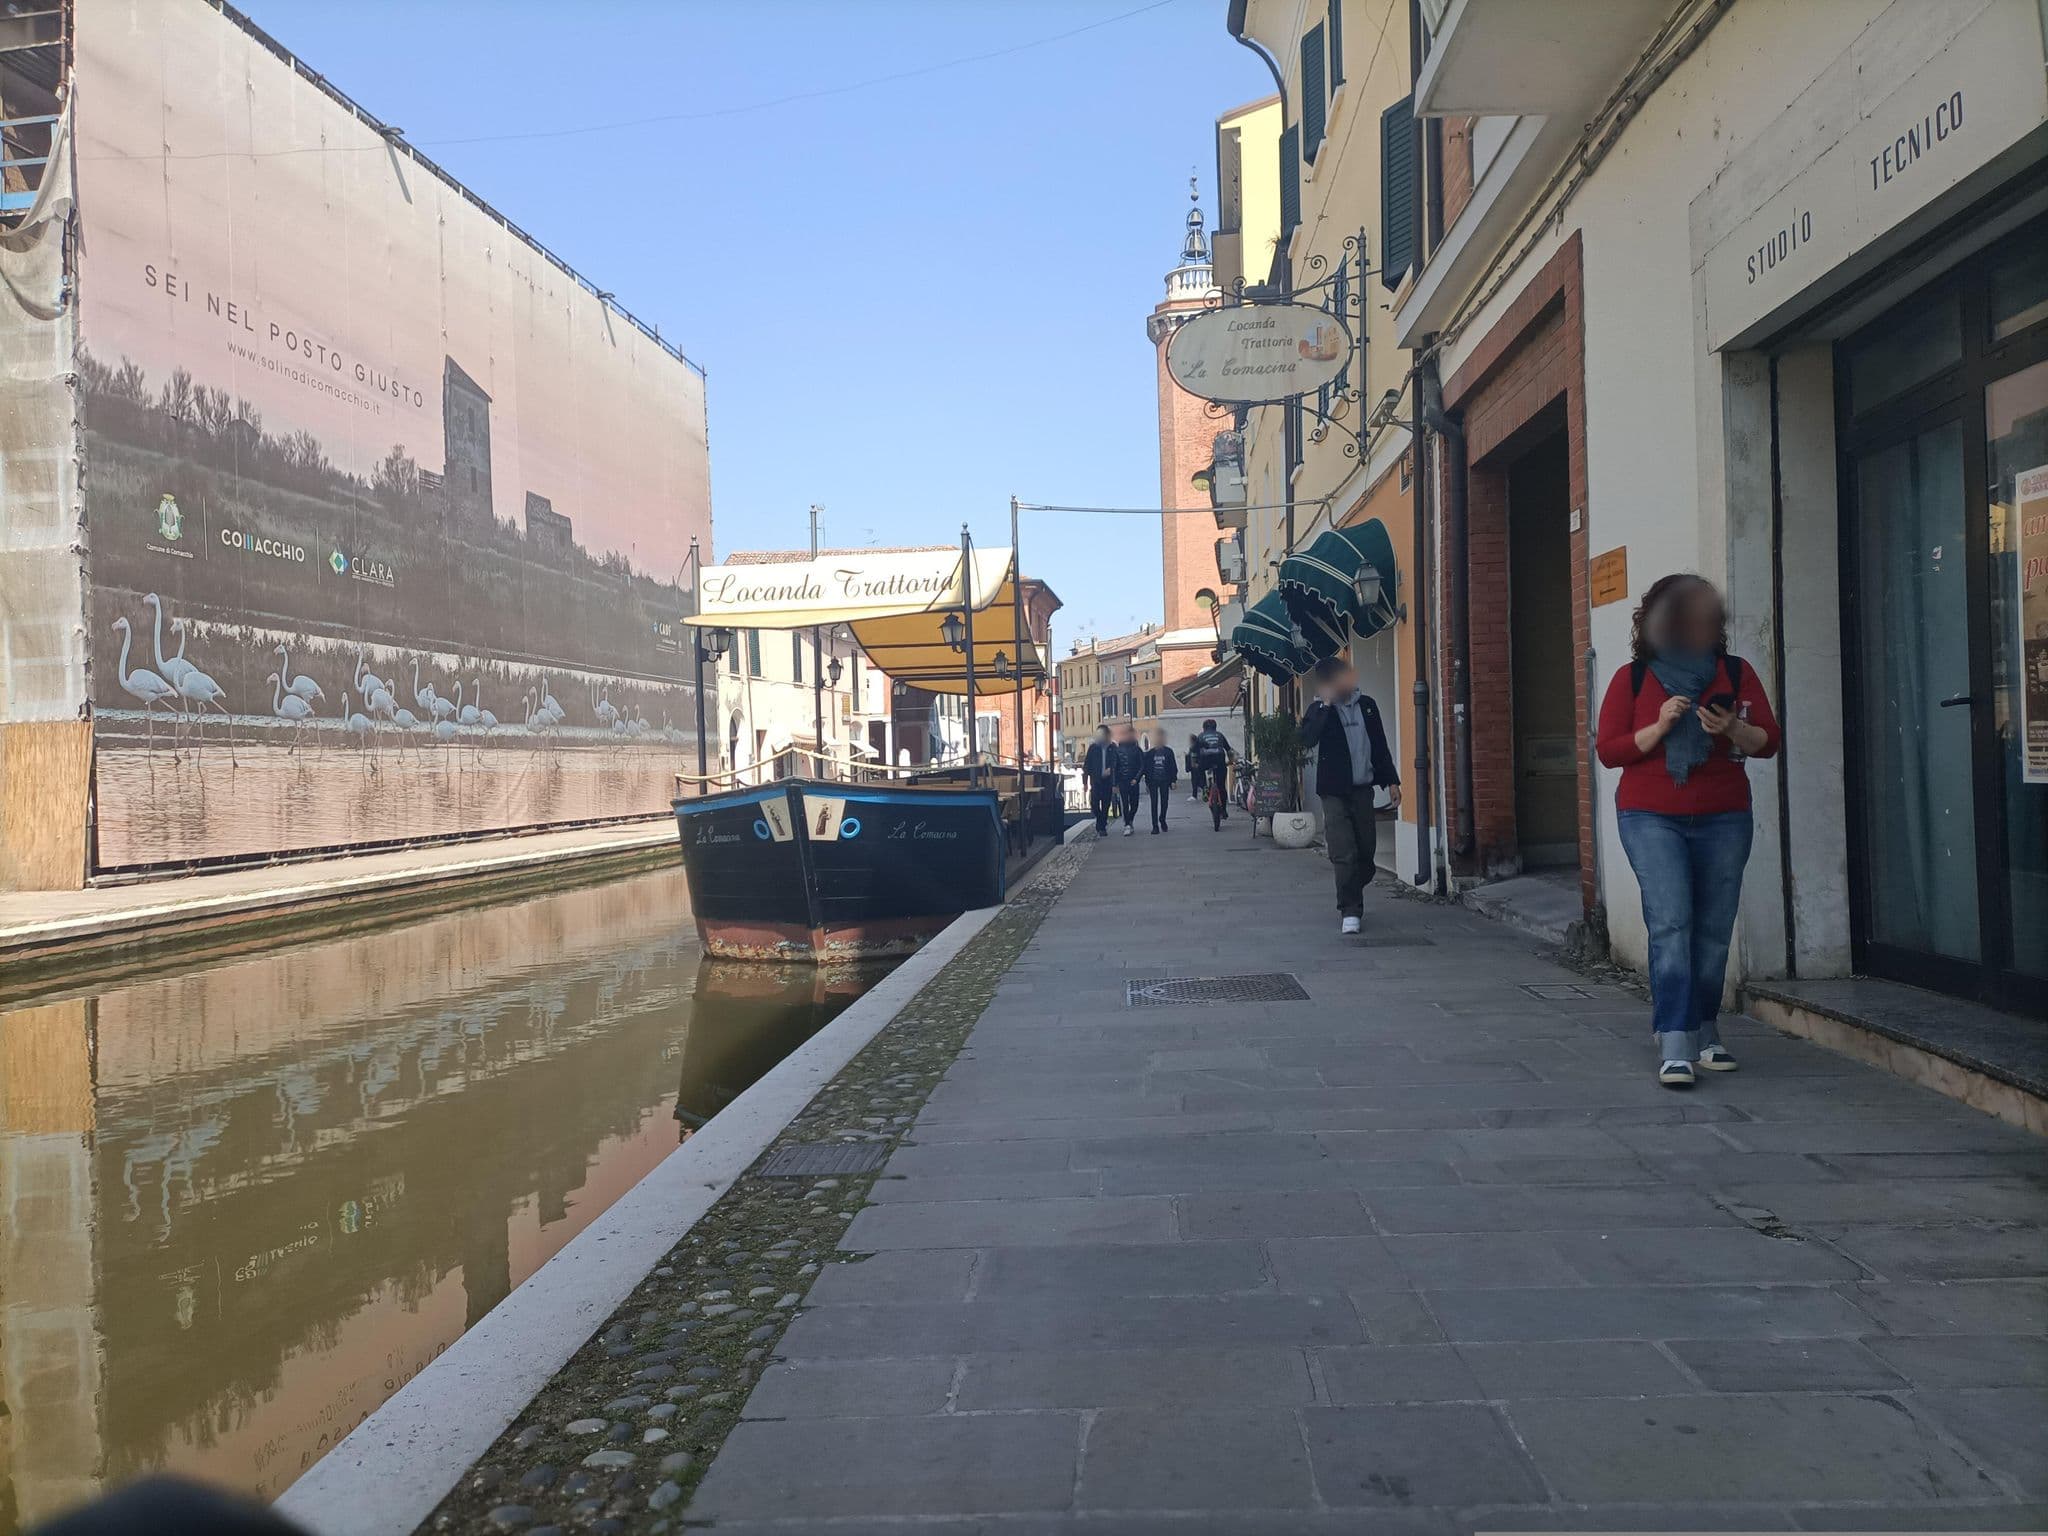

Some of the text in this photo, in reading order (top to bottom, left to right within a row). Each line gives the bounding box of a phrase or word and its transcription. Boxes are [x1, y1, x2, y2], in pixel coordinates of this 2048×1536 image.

[1747, 90, 1964, 285] STUDIO TECNICO
[144, 263, 424, 408] SEI NEL POSTO GIUSTO
[1226, 316, 1276, 332] Locanda
[1241, 336, 1293, 350] Trattoria
[226, 340, 381, 416] www.salinadicomacchio.it
[351, 556, 395, 582] CLARA
[702, 569, 959, 604] Locanda Trattoria
[887, 821, 907, 840] La
